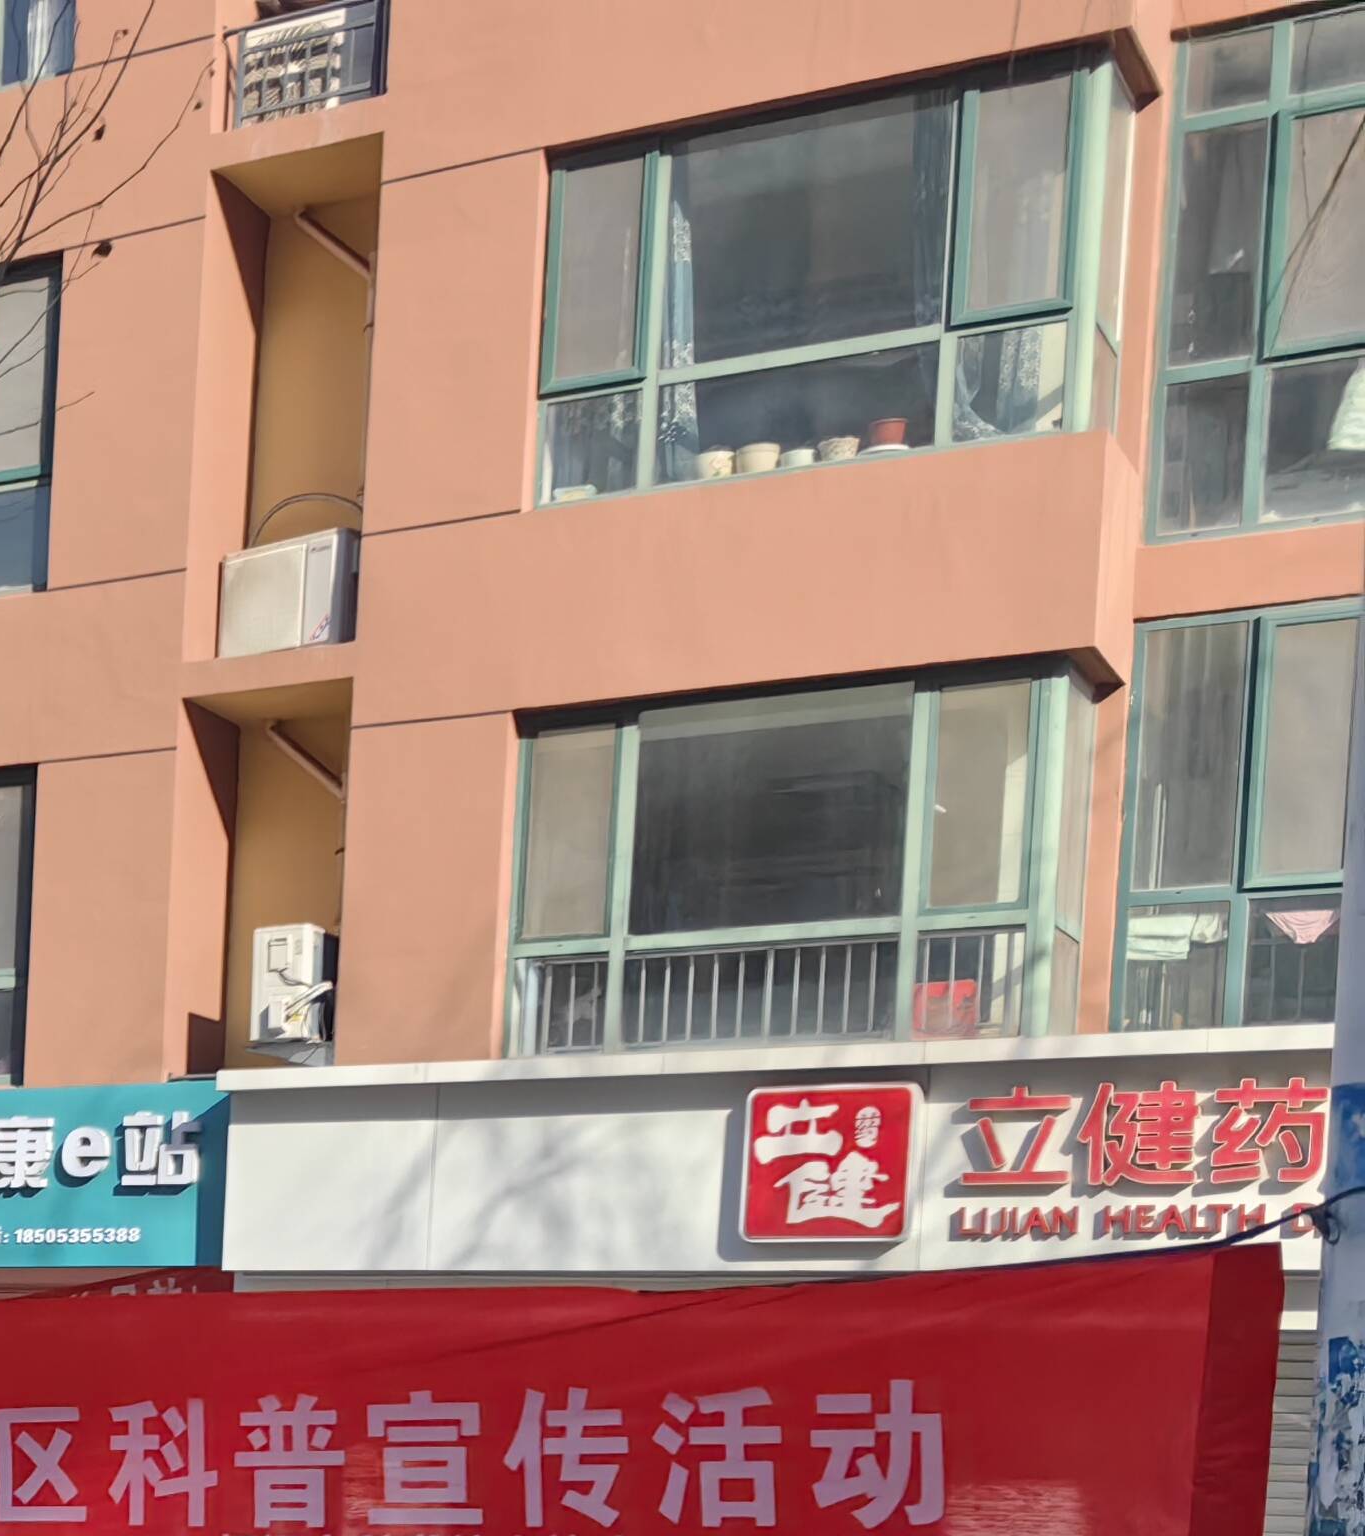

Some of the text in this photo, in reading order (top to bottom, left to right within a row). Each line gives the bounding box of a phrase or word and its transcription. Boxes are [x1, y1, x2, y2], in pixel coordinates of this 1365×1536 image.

[960, 1077, 1330, 1186] 立健药
[955, 1204, 1079, 1238] LIJIAN
[1103, 1202, 1266, 1236] HEALTH
